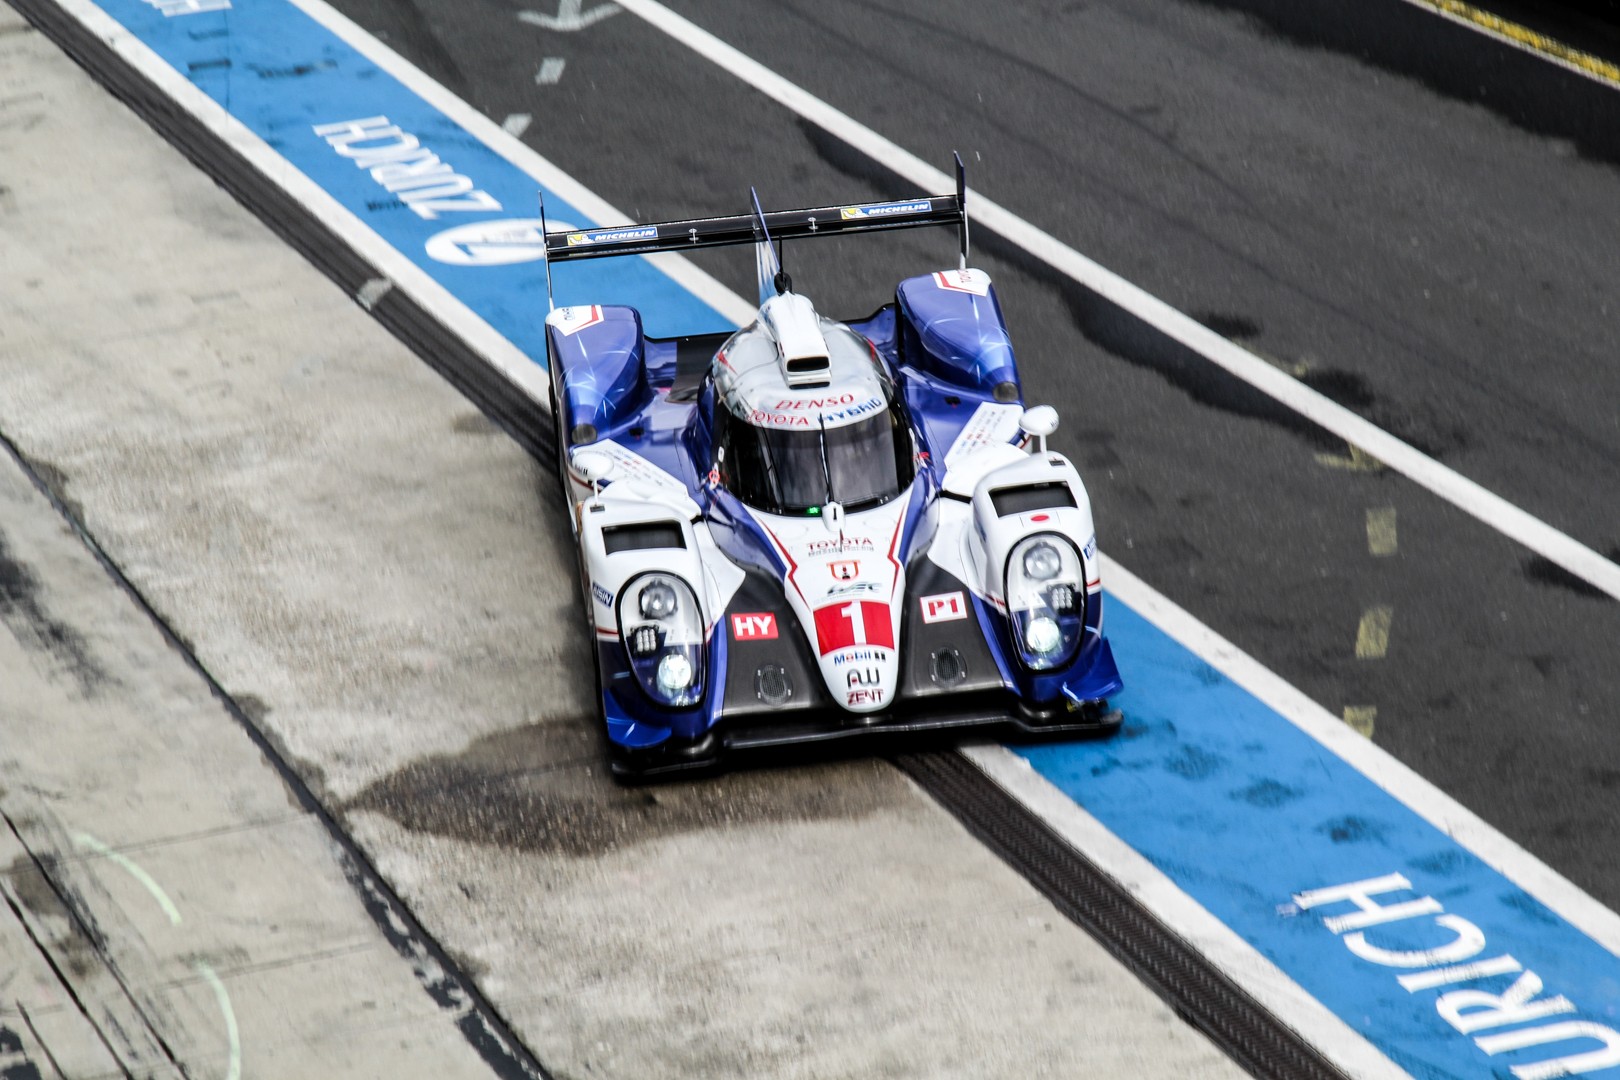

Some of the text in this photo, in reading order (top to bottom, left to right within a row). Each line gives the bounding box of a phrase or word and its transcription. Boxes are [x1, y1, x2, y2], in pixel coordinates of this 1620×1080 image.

[313, 115, 502, 220] ZURICH
[868, 203, 929, 215] MICHELIN
[594, 229, 655, 241] MICHELIN
[775, 393, 854, 410] DENSO
[748, 398, 882, 426] TOYOTA HYBRID
[807, 537, 873, 551] TOYOTA
[927, 597, 959, 617] P1
[734, 616, 772, 637] HY
[841, 599, 867, 645] 1
[834, 650, 871, 666] Mobil
[847, 689, 884, 706] ZENT
